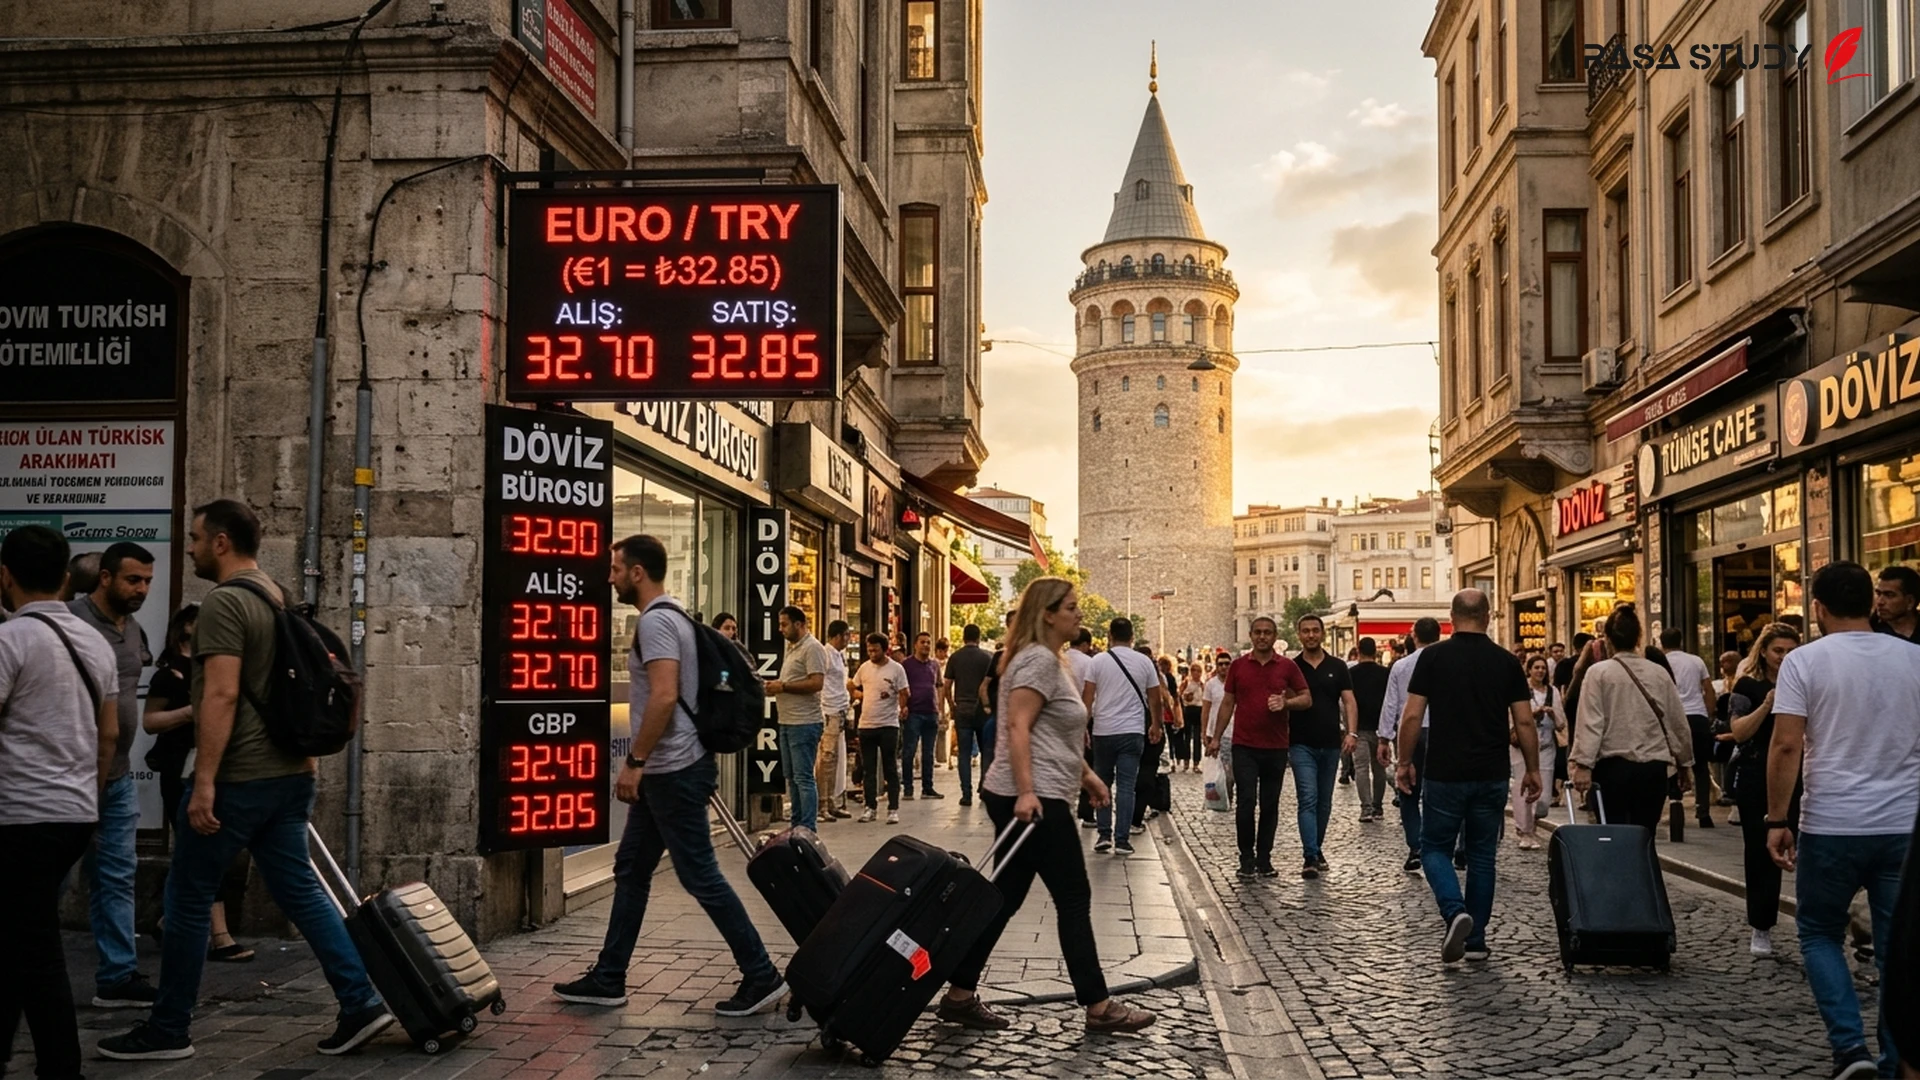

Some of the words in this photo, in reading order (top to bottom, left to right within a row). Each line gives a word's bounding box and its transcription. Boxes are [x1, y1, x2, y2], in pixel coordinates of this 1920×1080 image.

[546, 206, 673, 244] EURO
[684, 204, 700, 242] /
[711, 204, 801, 241] TRY
[562, 256, 611, 294] (€1
[625, 263, 646, 279] =
[555, 298, 623, 330] ALİŞ:
[712, 300, 797, 328] SATIŞ:
[526, 335, 654, 380] 32.70
[691, 334, 819, 379] 32.85
[1820, 333, 1920, 430] DÖVİZ
[503, 422, 605, 471] DÖVİZ
[1713, 404, 1757, 456] CAFE
[501, 469, 605, 508] BÜROSU
[511, 515, 599, 556] 32.90
[525, 567, 584, 601] ALİŞ:
[756, 518, 780, 677] DÖVİZ
[511, 603, 598, 641] 32.70
[511, 652, 598, 690] 32.70
[528, 712, 577, 736] GBP
[510, 742, 596, 782] 32.40
[510, 792, 596, 833] 32.85
